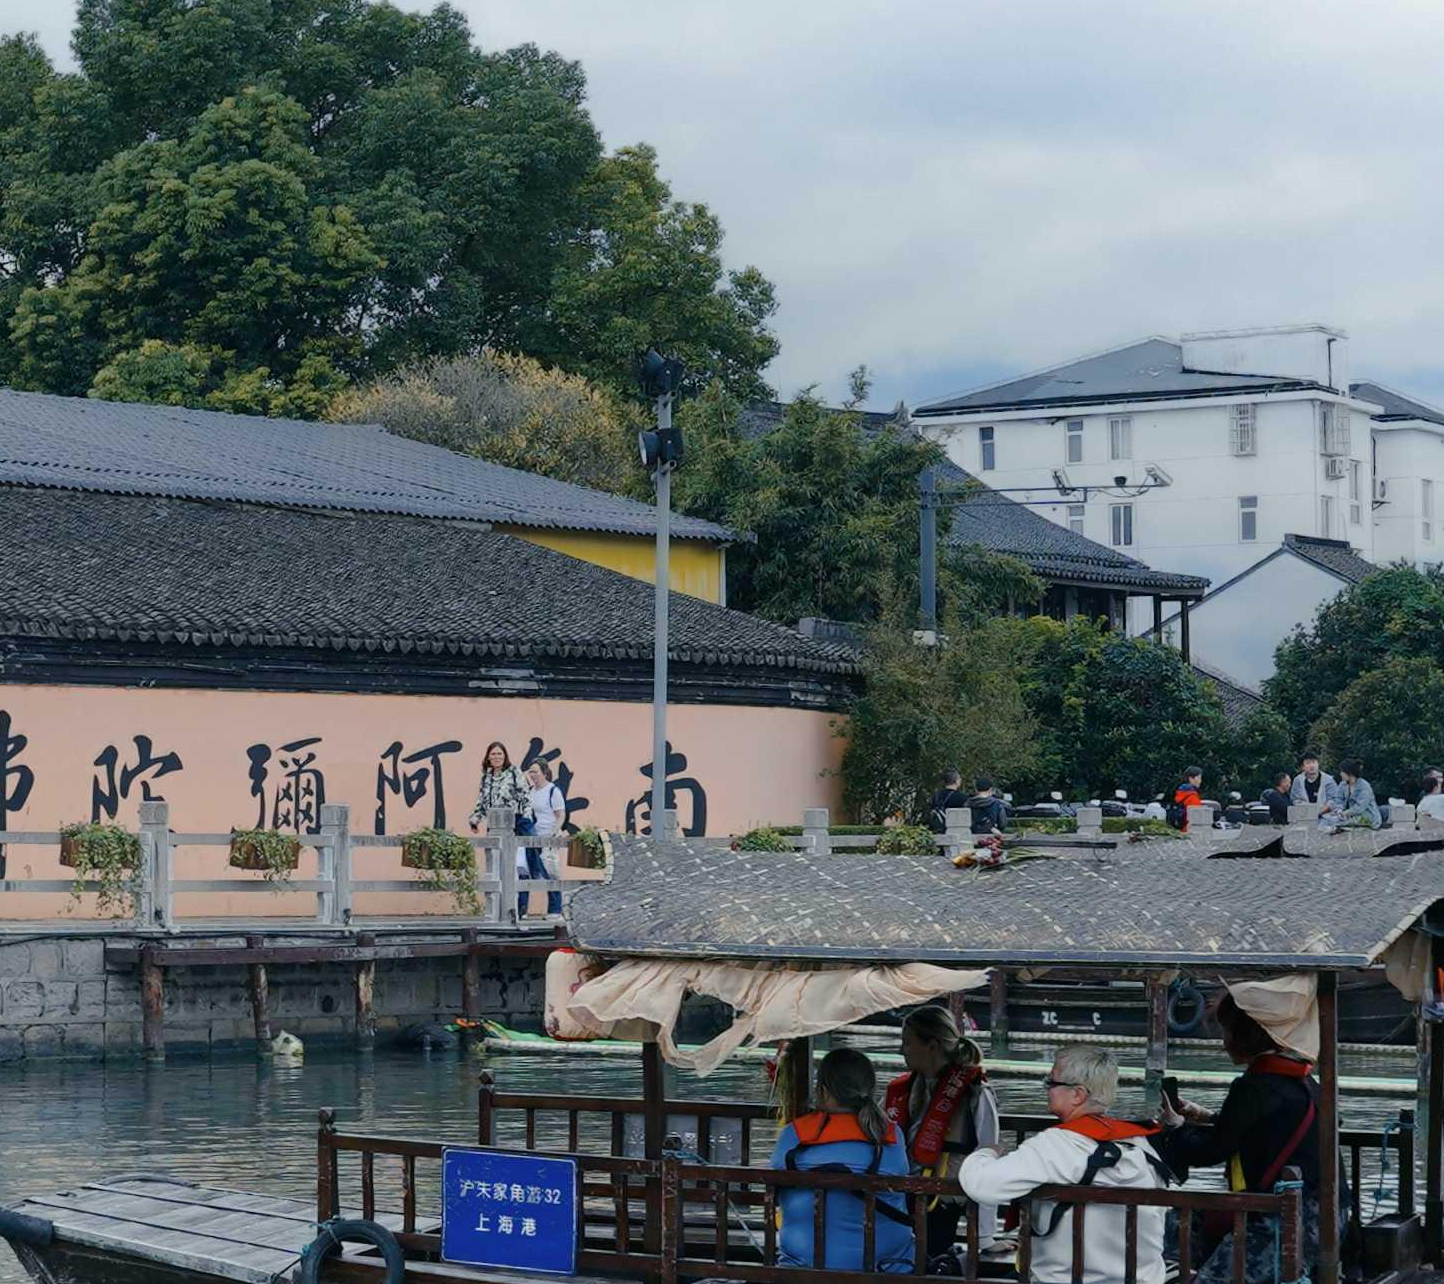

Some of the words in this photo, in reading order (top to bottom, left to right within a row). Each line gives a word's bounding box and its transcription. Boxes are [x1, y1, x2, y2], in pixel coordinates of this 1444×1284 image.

[459, 1178, 562, 1205] 沪朱家角游32
[475, 1213, 538, 1237] 上海港
